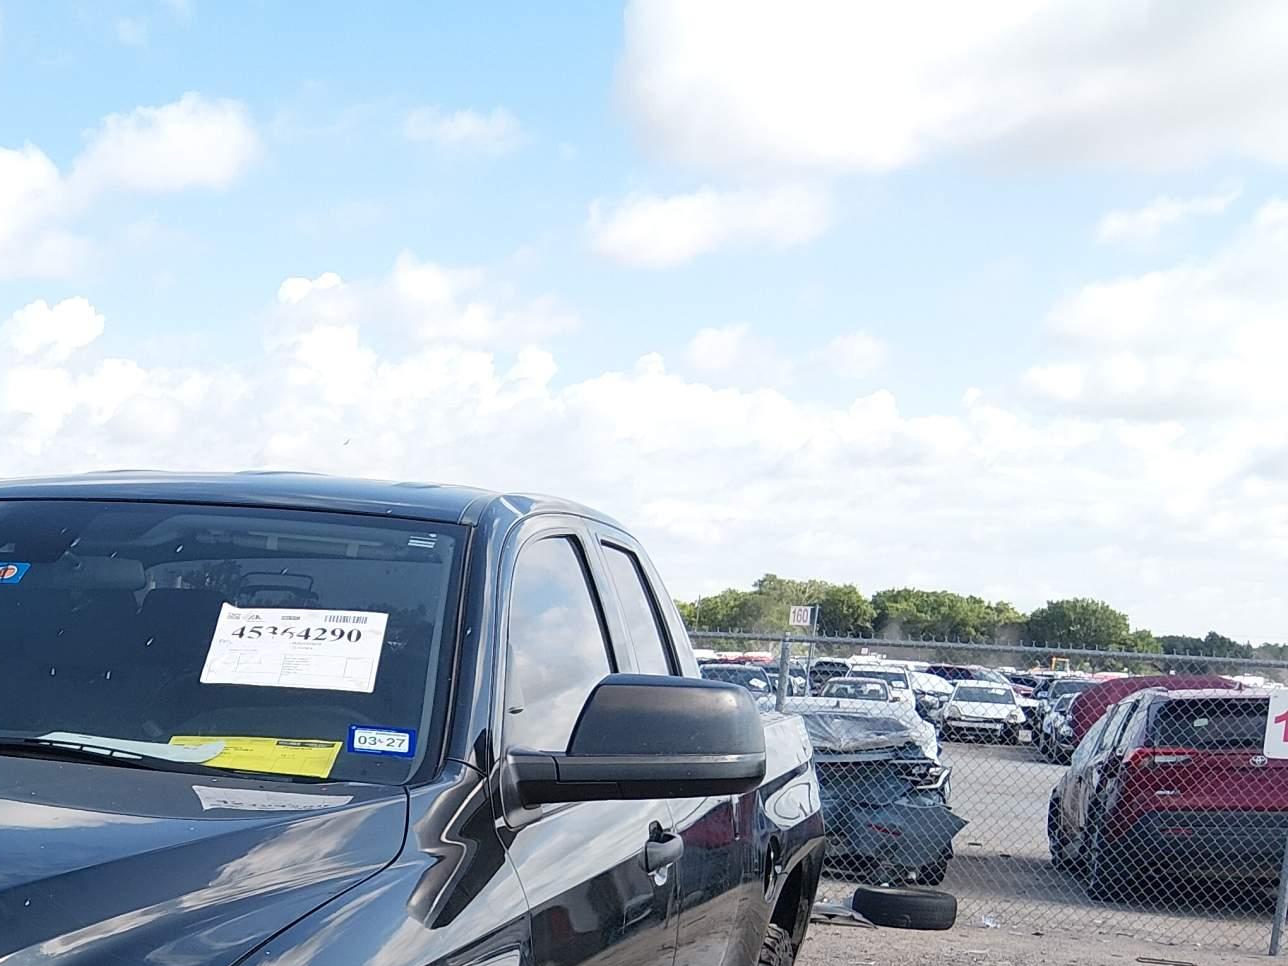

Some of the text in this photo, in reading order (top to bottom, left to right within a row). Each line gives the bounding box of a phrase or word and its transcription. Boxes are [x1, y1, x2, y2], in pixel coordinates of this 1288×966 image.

[792, 608, 809, 623] 160
[231, 625, 362, 643] 45364290
[358, 735, 406, 748] 03 27
